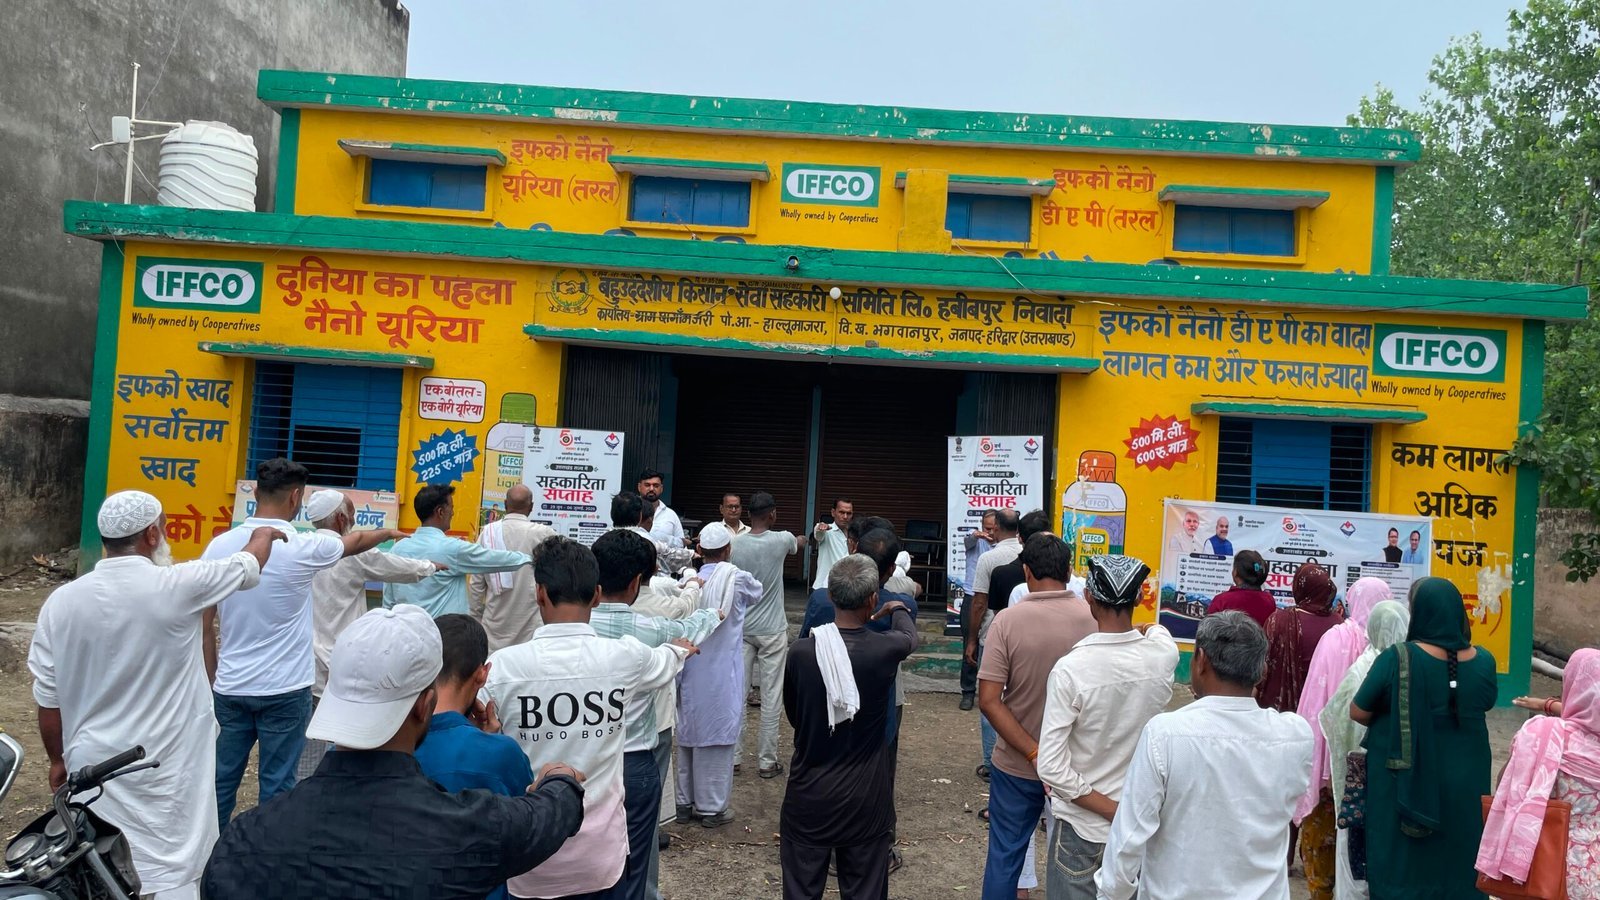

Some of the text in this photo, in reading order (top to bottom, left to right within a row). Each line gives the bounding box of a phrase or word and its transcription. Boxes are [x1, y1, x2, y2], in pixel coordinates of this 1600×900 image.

[510, 134, 615, 163] इफको नैनो
[502, 168, 562, 201] यूरिया
[797, 172, 865, 197] IFFCO
[1053, 164, 1157, 193] इफको नैनो
[780, 208, 879, 224] Wholly owned by Cooperatives
[156, 270, 244, 299] IFFCO
[276, 255, 517, 309] दुनिया का पहला
[841, 287, 898, 315] समिति
[131, 312, 261, 334] Wholly owned by Cooperatives
[305, 298, 485, 348] नैनो यूरिया
[1098, 305, 1176, 343] इफको
[1177, 305, 1227, 343] नैनो
[1331, 323, 1373, 356] वादा
[1395, 337, 1487, 368] IFFCO
[1102, 350, 1171, 380] लागत
[1173, 355, 1211, 381] कम
[1212, 348, 1260, 384] और
[1262, 360, 1321, 389] फसल
[117, 369, 234, 408] इफको खाद
[1370, 380, 1507, 402] Wholly owned by Cooperatives
[123, 408, 230, 442] सर्वोत्तम
[1131, 434, 1151, 451] 500
[1391, 441, 1439, 469] कम
[139, 456, 200, 487] खाद
[418, 450, 437, 467] 500
[536, 473, 607, 491] सहकारिता
[543, 488, 594, 504] सप्ताह
[961, 479, 1028, 496] सहकारिता
[968, 495, 1017, 509] सप्ताह
[1414, 482, 1498, 520] अधिक
[517, 687, 626, 729] BOSS
[520, 722, 623, 742] HUGO BOSS
